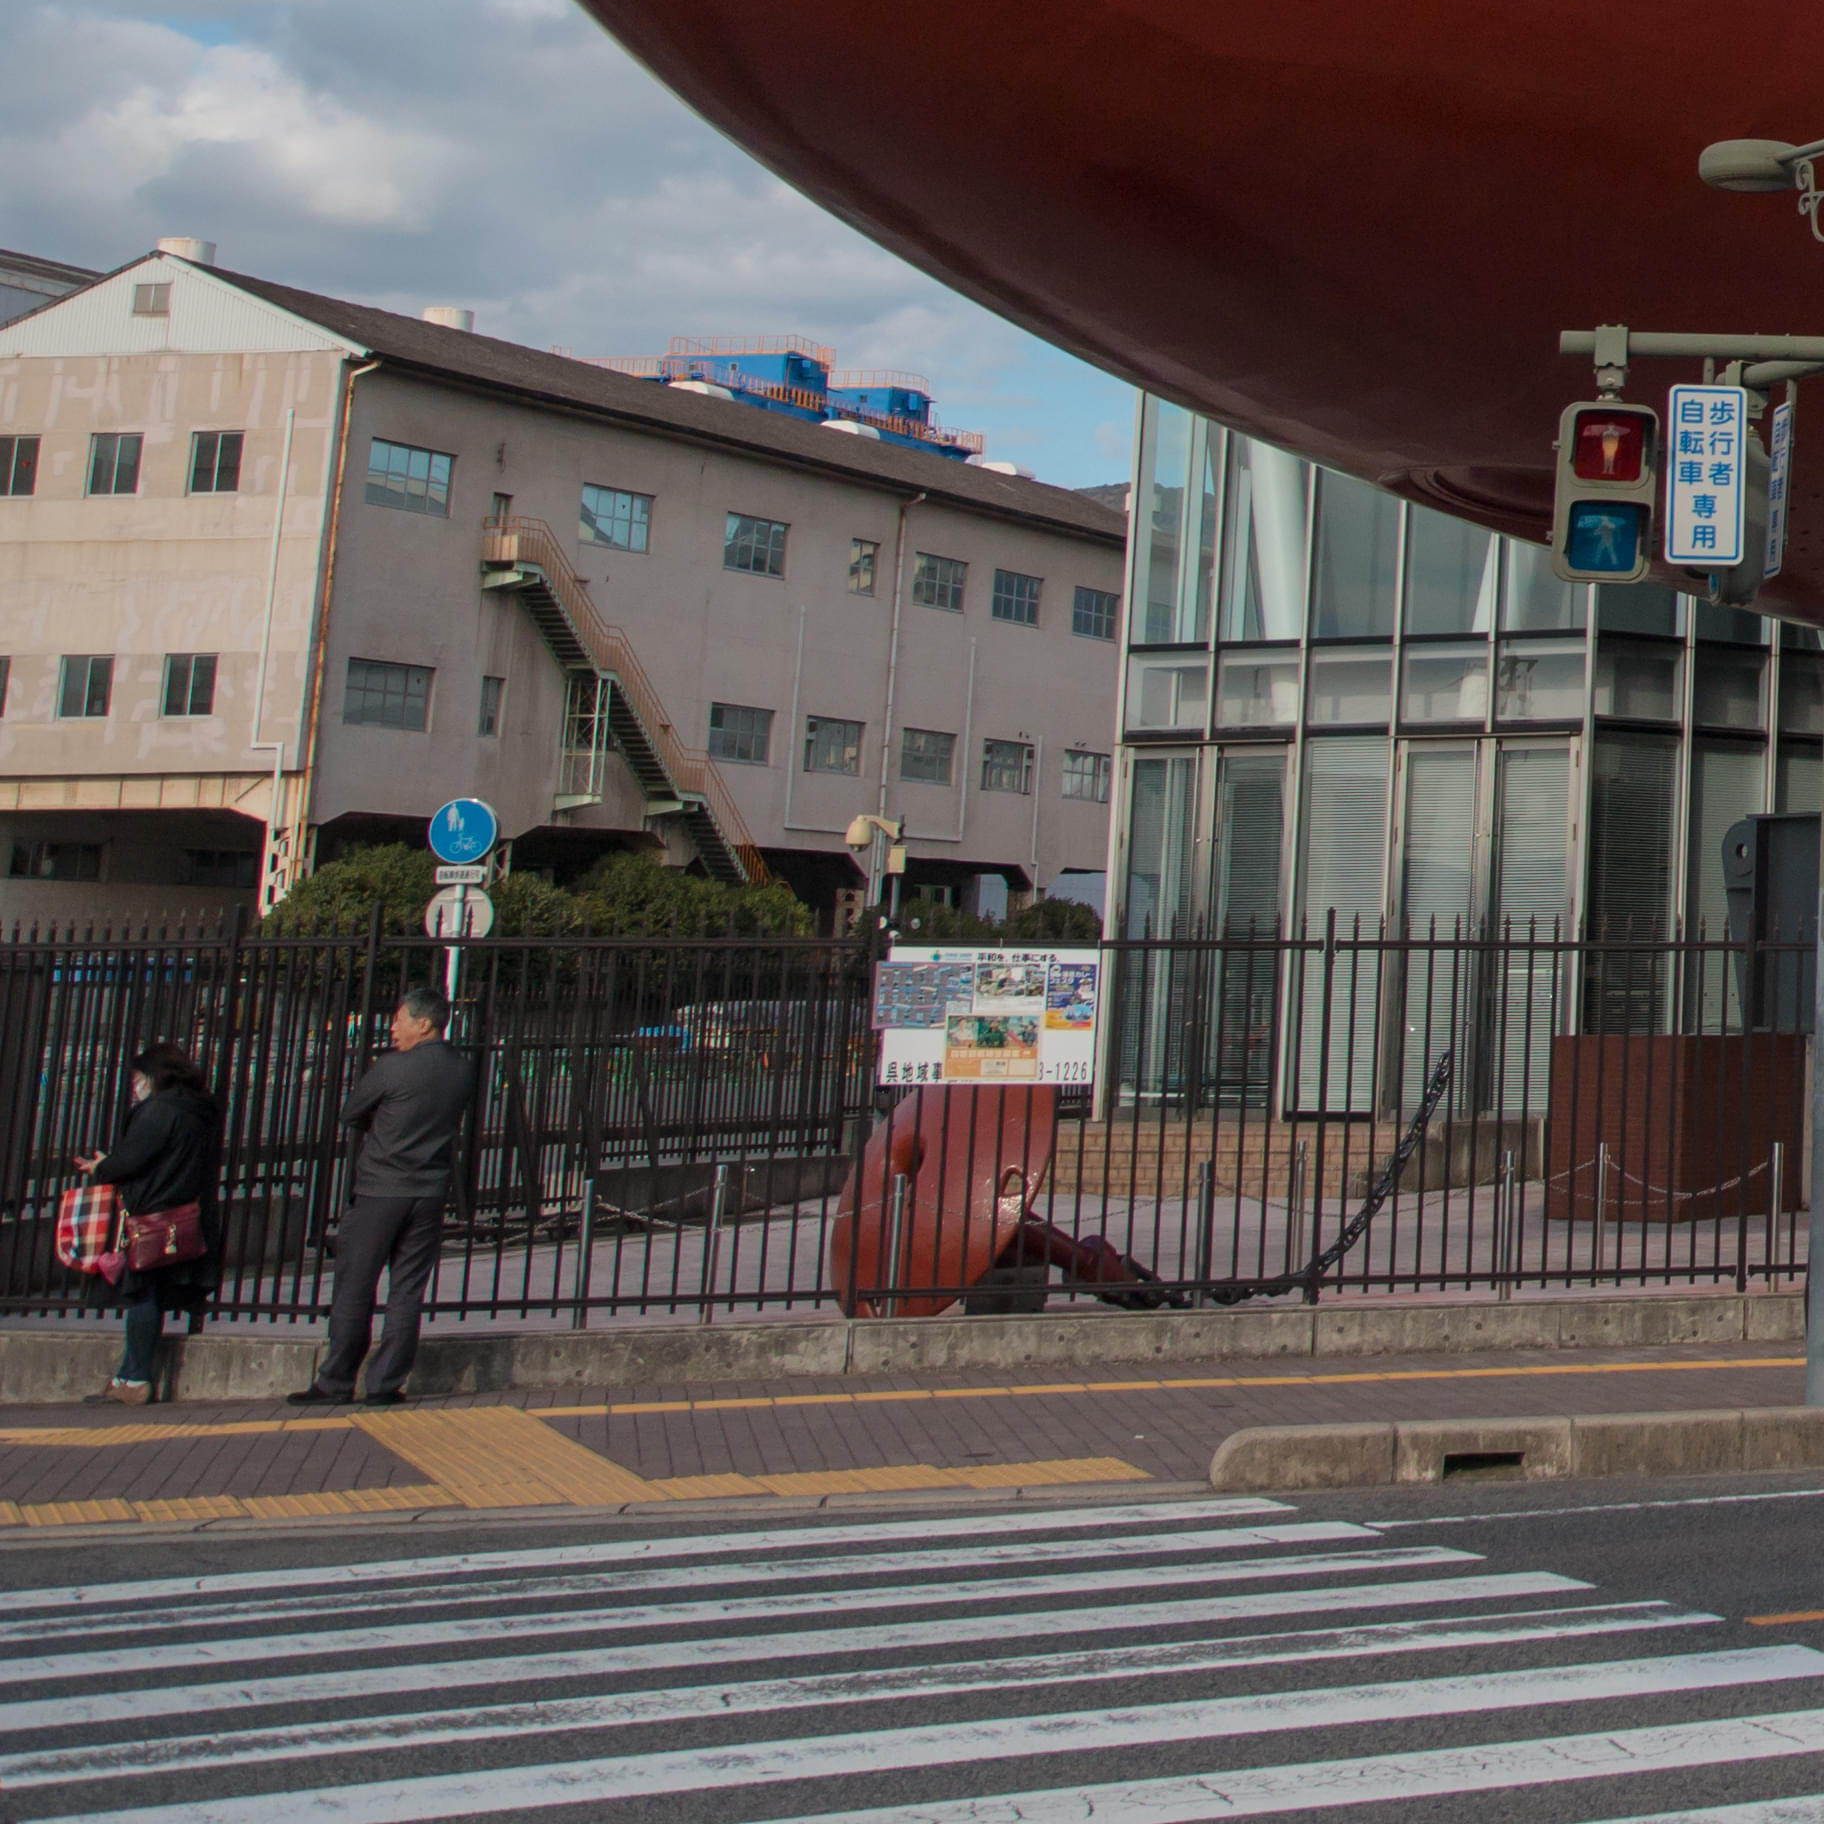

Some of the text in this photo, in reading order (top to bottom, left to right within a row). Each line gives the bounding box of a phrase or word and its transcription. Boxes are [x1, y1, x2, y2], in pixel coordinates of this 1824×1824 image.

[1678, 400, 1704, 486] 自転車
[1709, 400, 1735, 486] 歩行者
[1691, 494, 1717, 549] 専用
